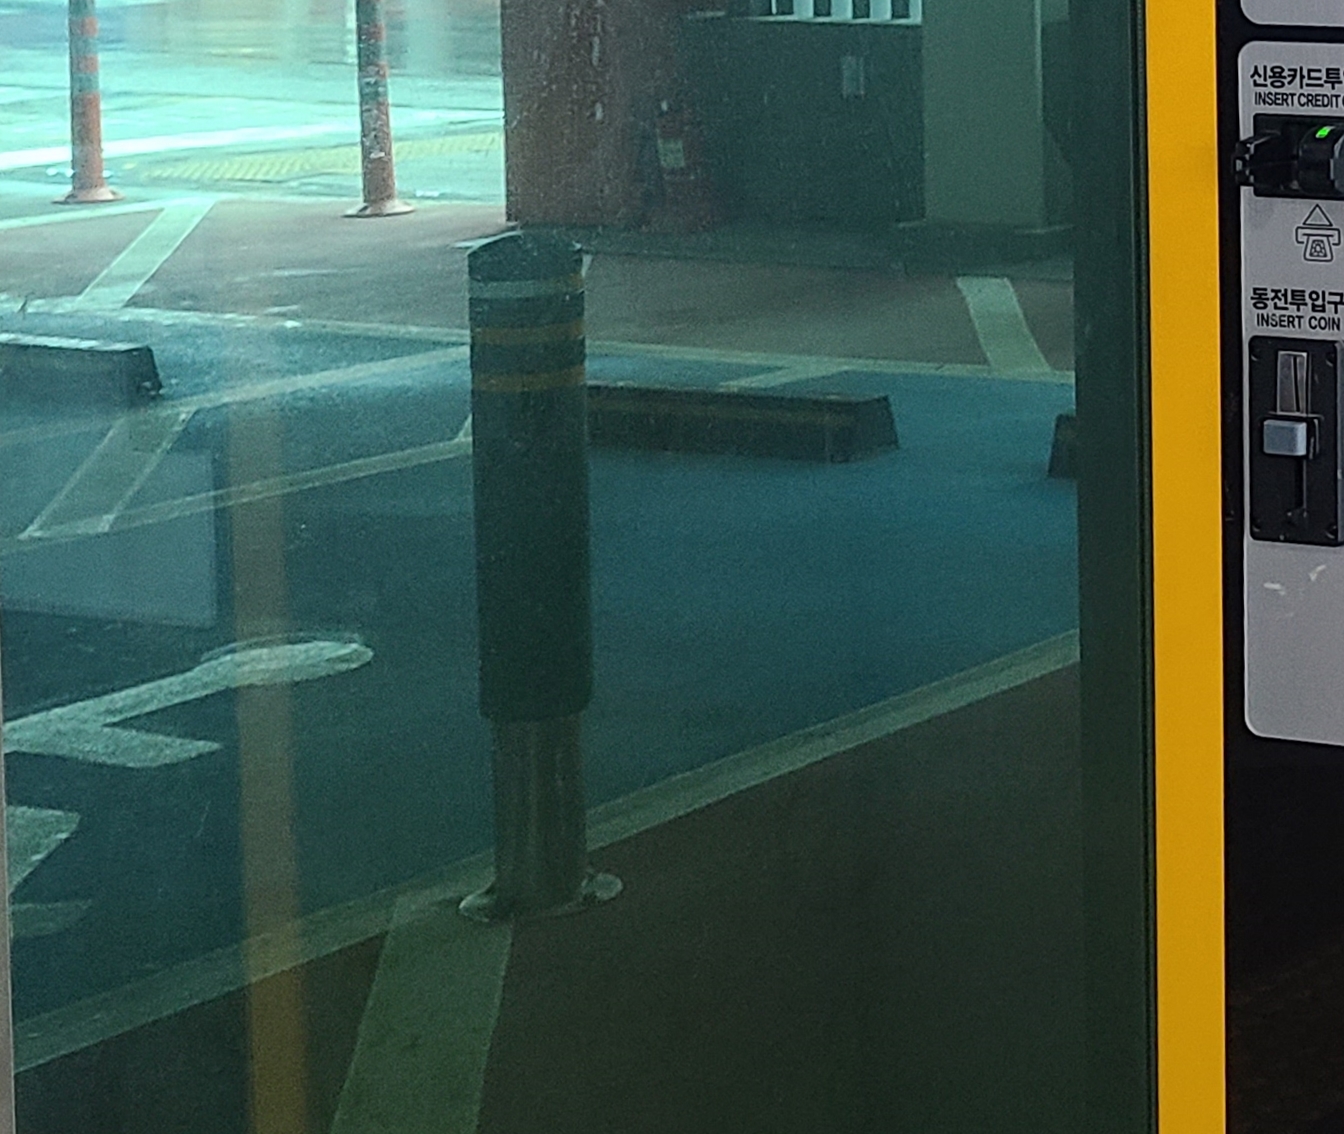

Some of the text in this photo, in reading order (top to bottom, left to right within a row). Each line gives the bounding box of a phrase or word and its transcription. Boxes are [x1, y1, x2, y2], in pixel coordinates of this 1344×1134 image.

[1254, 91, 1297, 107] INSERT
[1297, 92, 1341, 108] CREDIT
[1256, 313, 1340, 331] INSERT COIN
